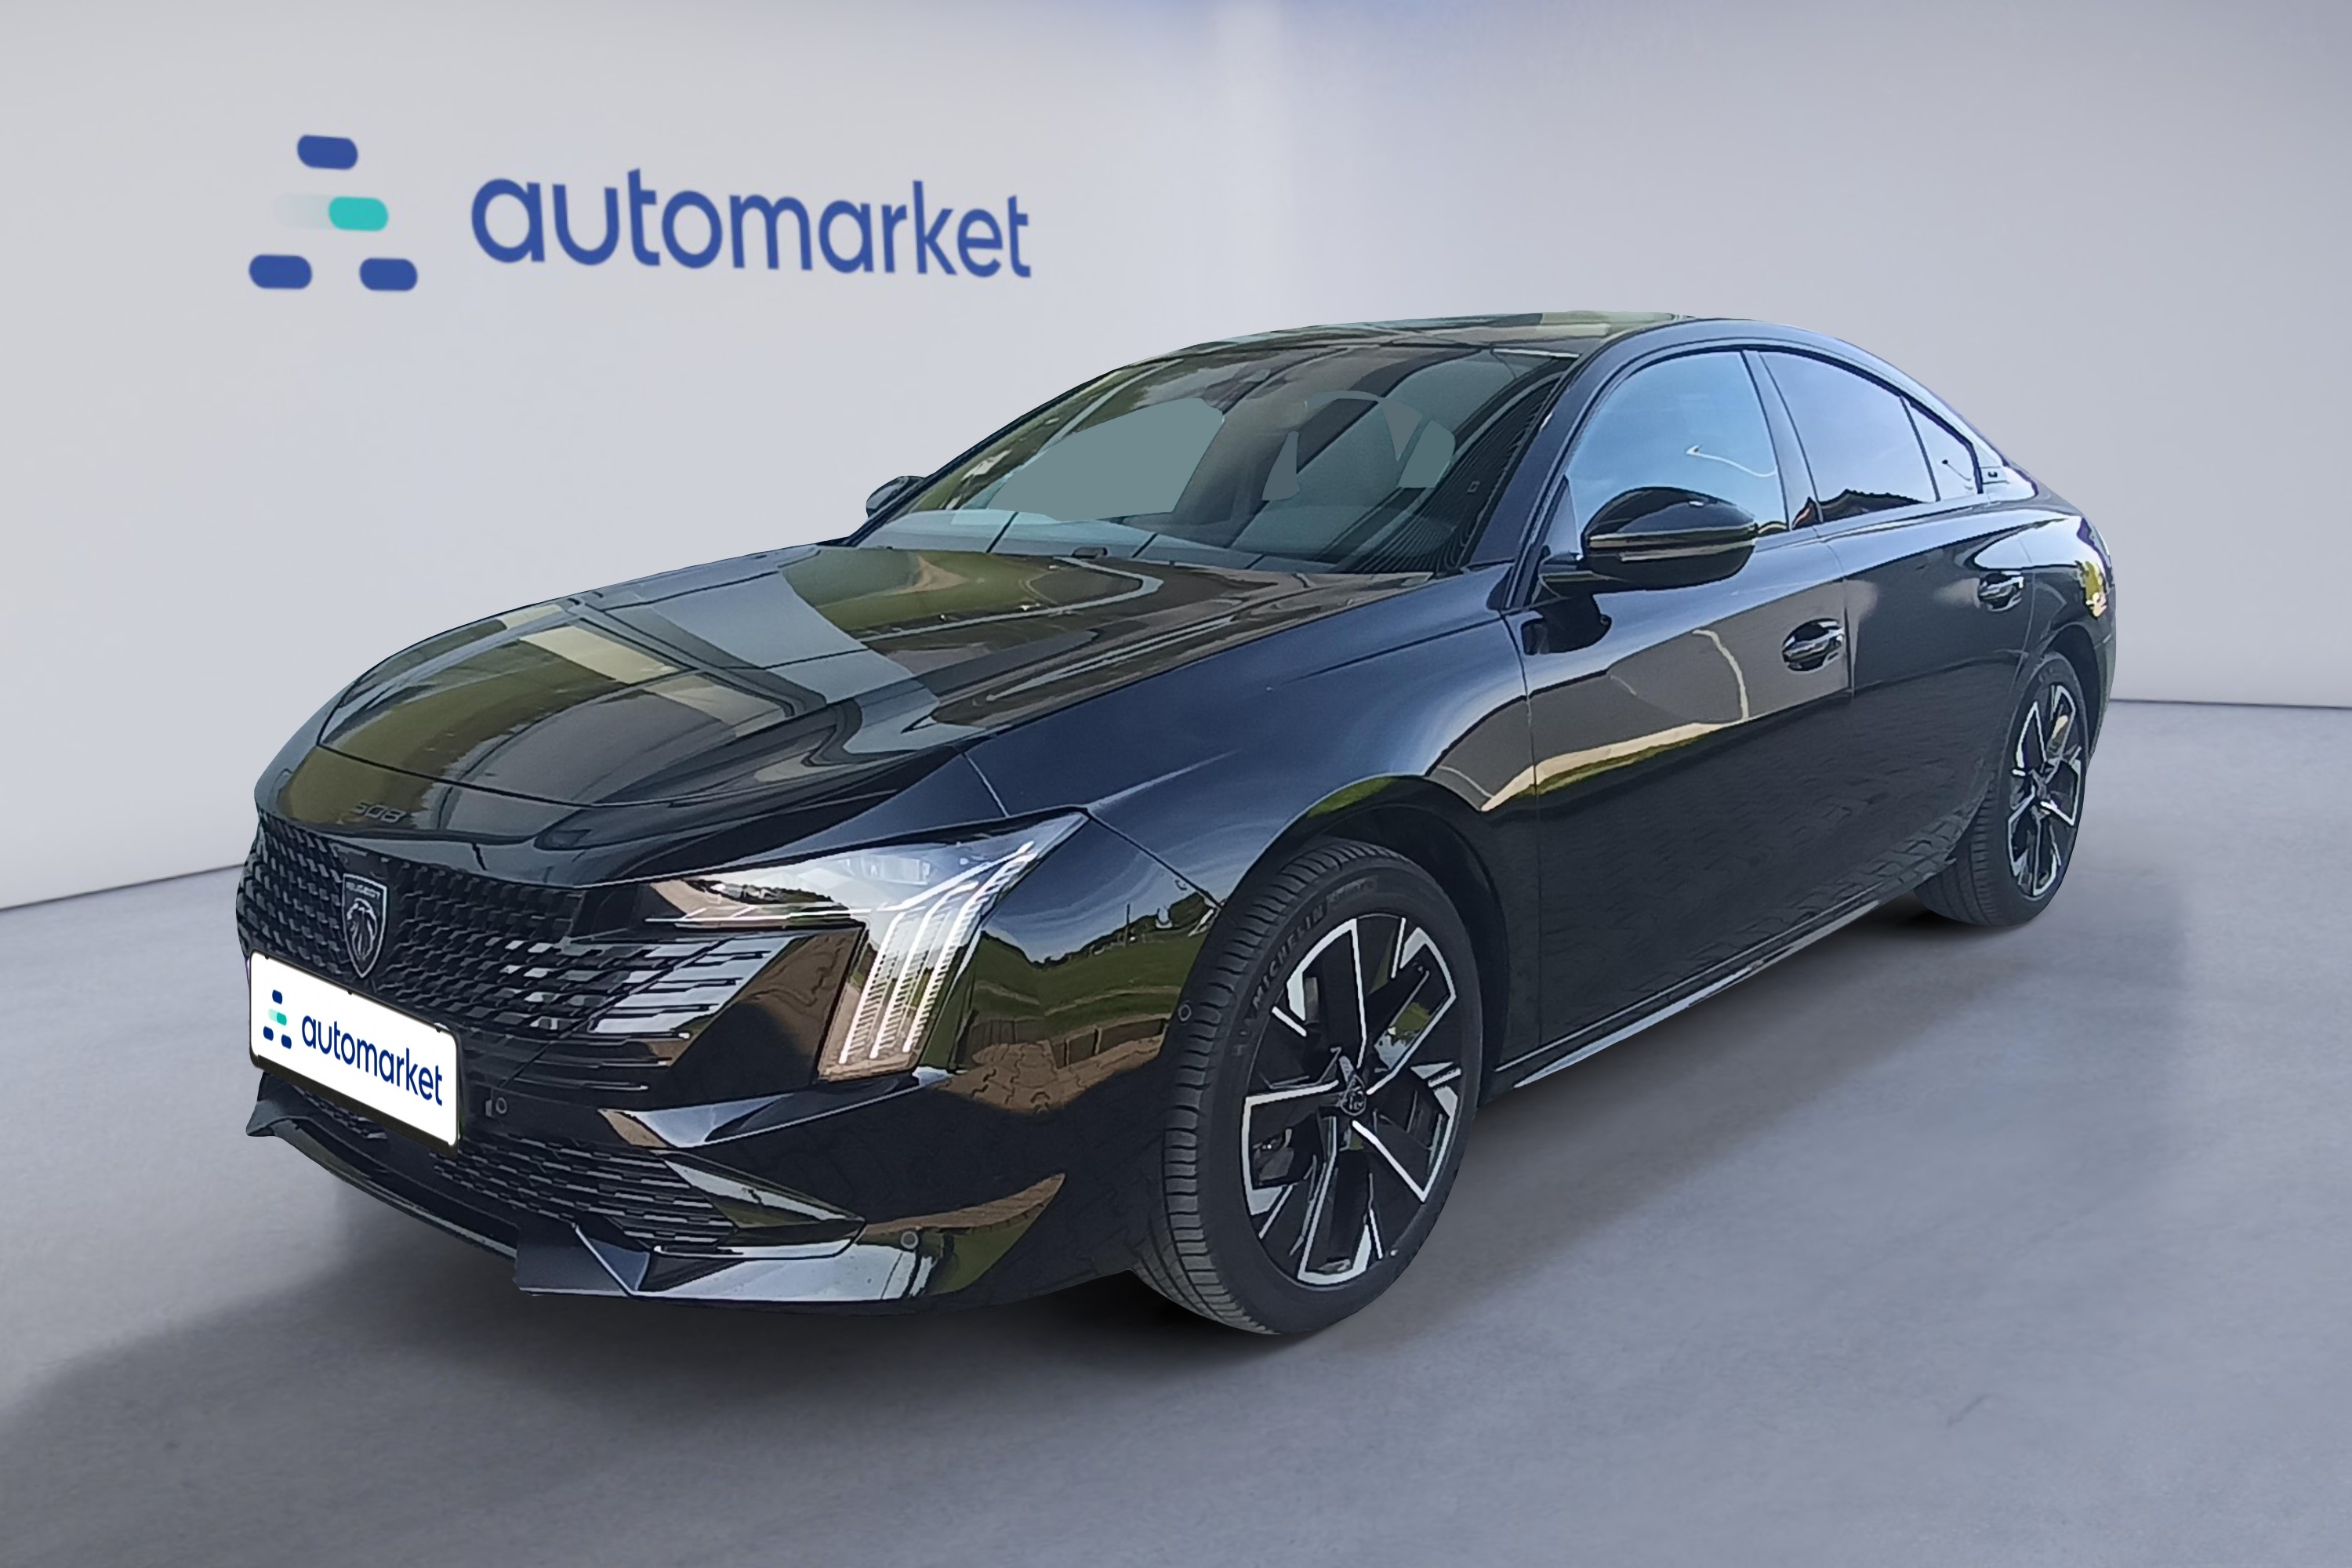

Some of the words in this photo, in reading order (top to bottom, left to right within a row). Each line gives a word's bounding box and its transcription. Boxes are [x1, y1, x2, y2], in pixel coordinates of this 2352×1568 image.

[471, 169, 1031, 278] automarket
[350, 801, 406, 823] 508
[1252, 904, 1324, 1010] MICHELIN
[301, 1014, 443, 1106] automarket
